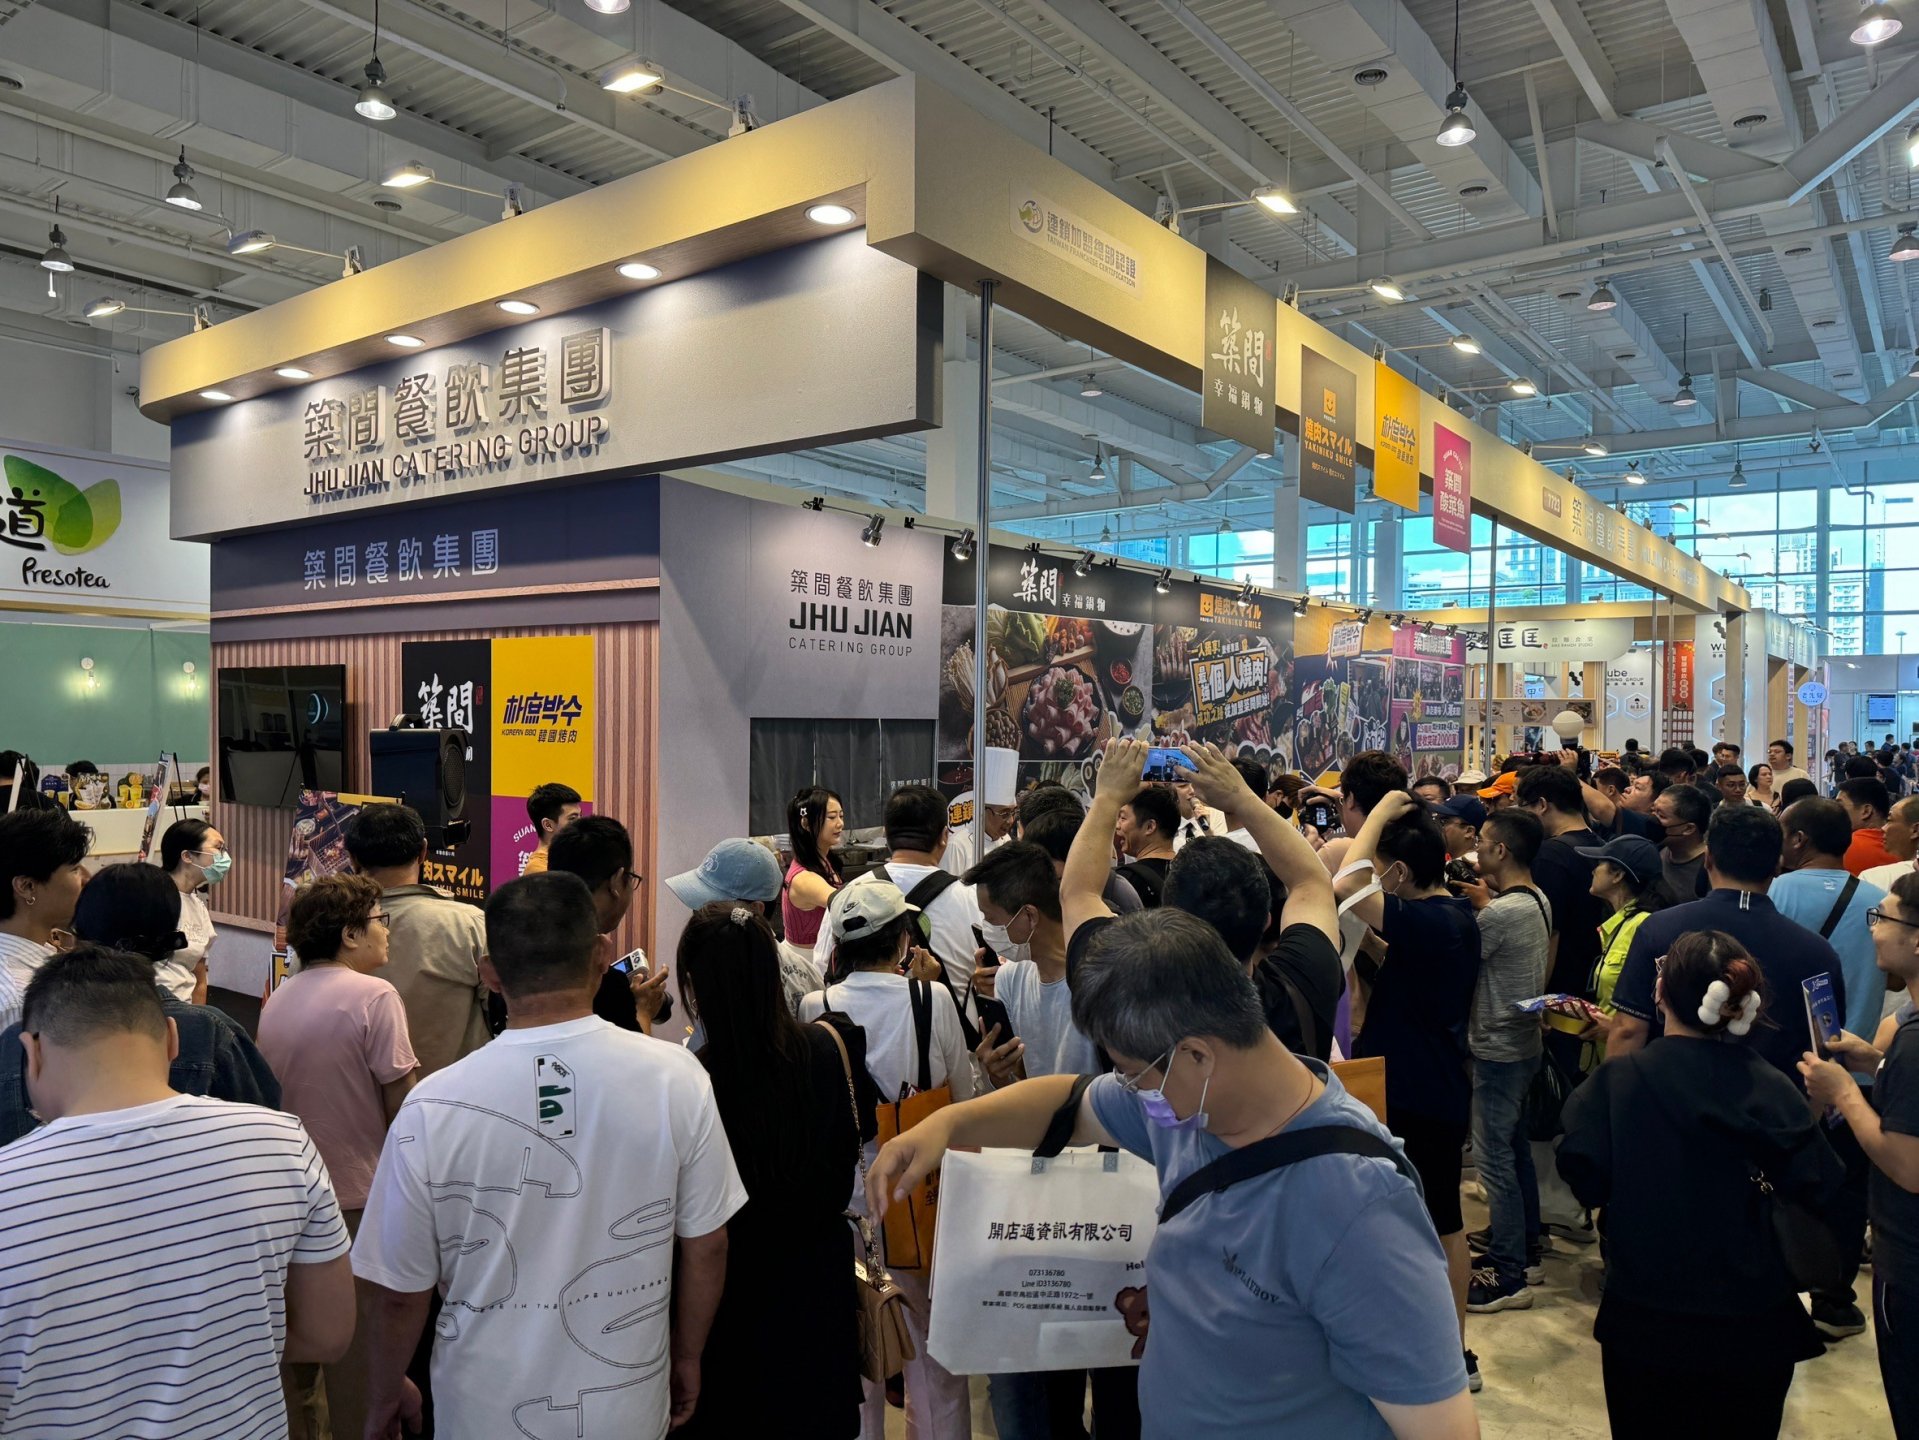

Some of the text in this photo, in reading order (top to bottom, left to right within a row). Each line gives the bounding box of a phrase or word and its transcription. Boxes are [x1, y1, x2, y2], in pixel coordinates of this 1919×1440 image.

[1047, 211, 1136, 279] 連鎖加盟總部認證
[1211, 306, 1264, 388] 築間
[304, 328, 605, 459] 築間餐飲集團
[1214, 378, 1263, 416] 幸福鍋物
[303, 415, 603, 496] JHU JIAN CATERING GROUP
[1304, 440, 1353, 468] YAKINIKU SMILE
[1440, 490, 1465, 520] 酸菜魚
[22, 556, 111, 589] Presotea
[304, 528, 499, 590] 築間餐飲集團
[790, 568, 913, 606] 築間餐飲集團
[1013, 558, 1058, 606] 築間
[1062, 593, 1106, 612] 幸福鍋物
[789, 601, 913, 639] JHU JIAN
[1244, 620, 1261, 629] SMILE
[788, 637, 913, 657] CATERING GROUP
[415, 673, 474, 735] 築間
[502, 729, 537, 737] KOREAN BBQ
[538, 729, 578, 744] 韓國烤肉
[456, 886, 484, 899] SMILE
[987, 1222, 1132, 1242] 開店通資訊有限公司
[1021, 1280, 1036, 1288] Line
[1028, 1269, 1066, 1277] 073136780
